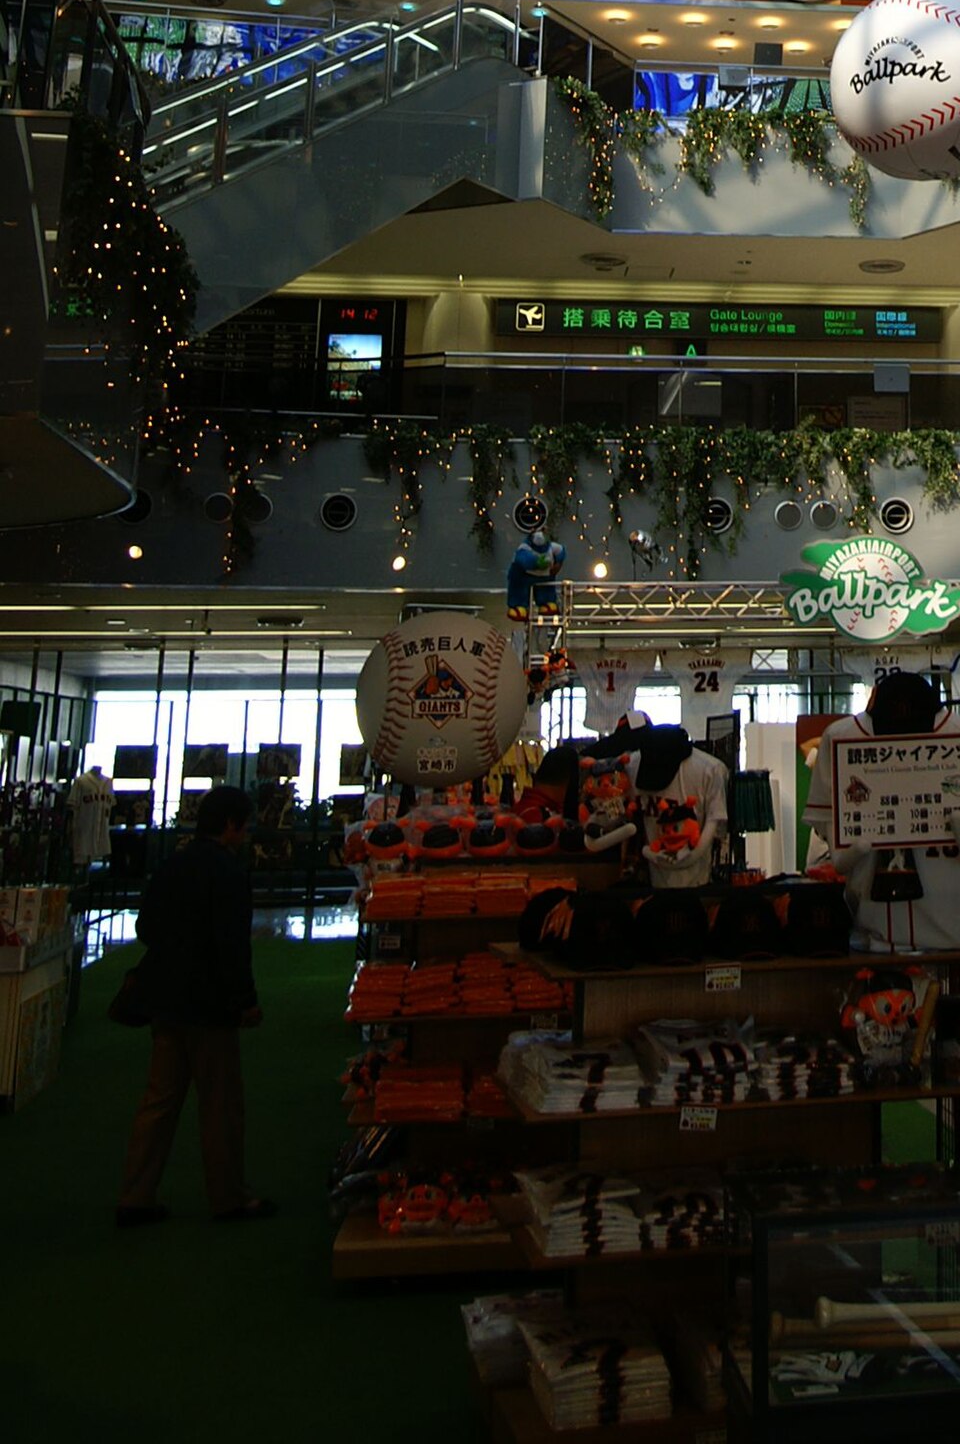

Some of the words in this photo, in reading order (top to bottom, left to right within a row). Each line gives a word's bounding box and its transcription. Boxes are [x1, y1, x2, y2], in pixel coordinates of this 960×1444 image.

[849, 56, 951, 94] Ballpark
[562, 307, 691, 330] 搭乗待合室
[709, 308, 738, 321] Gate
[741, 308, 784, 323] Lounge
[685, 343, 698, 356] A
[788, 570, 957, 623] Ballpark
[402, 636, 486, 657] 読売巨人軍
[606, 671, 616, 692] 1
[694, 671, 720, 693] 24
[419, 701, 462, 713] GIANTS
